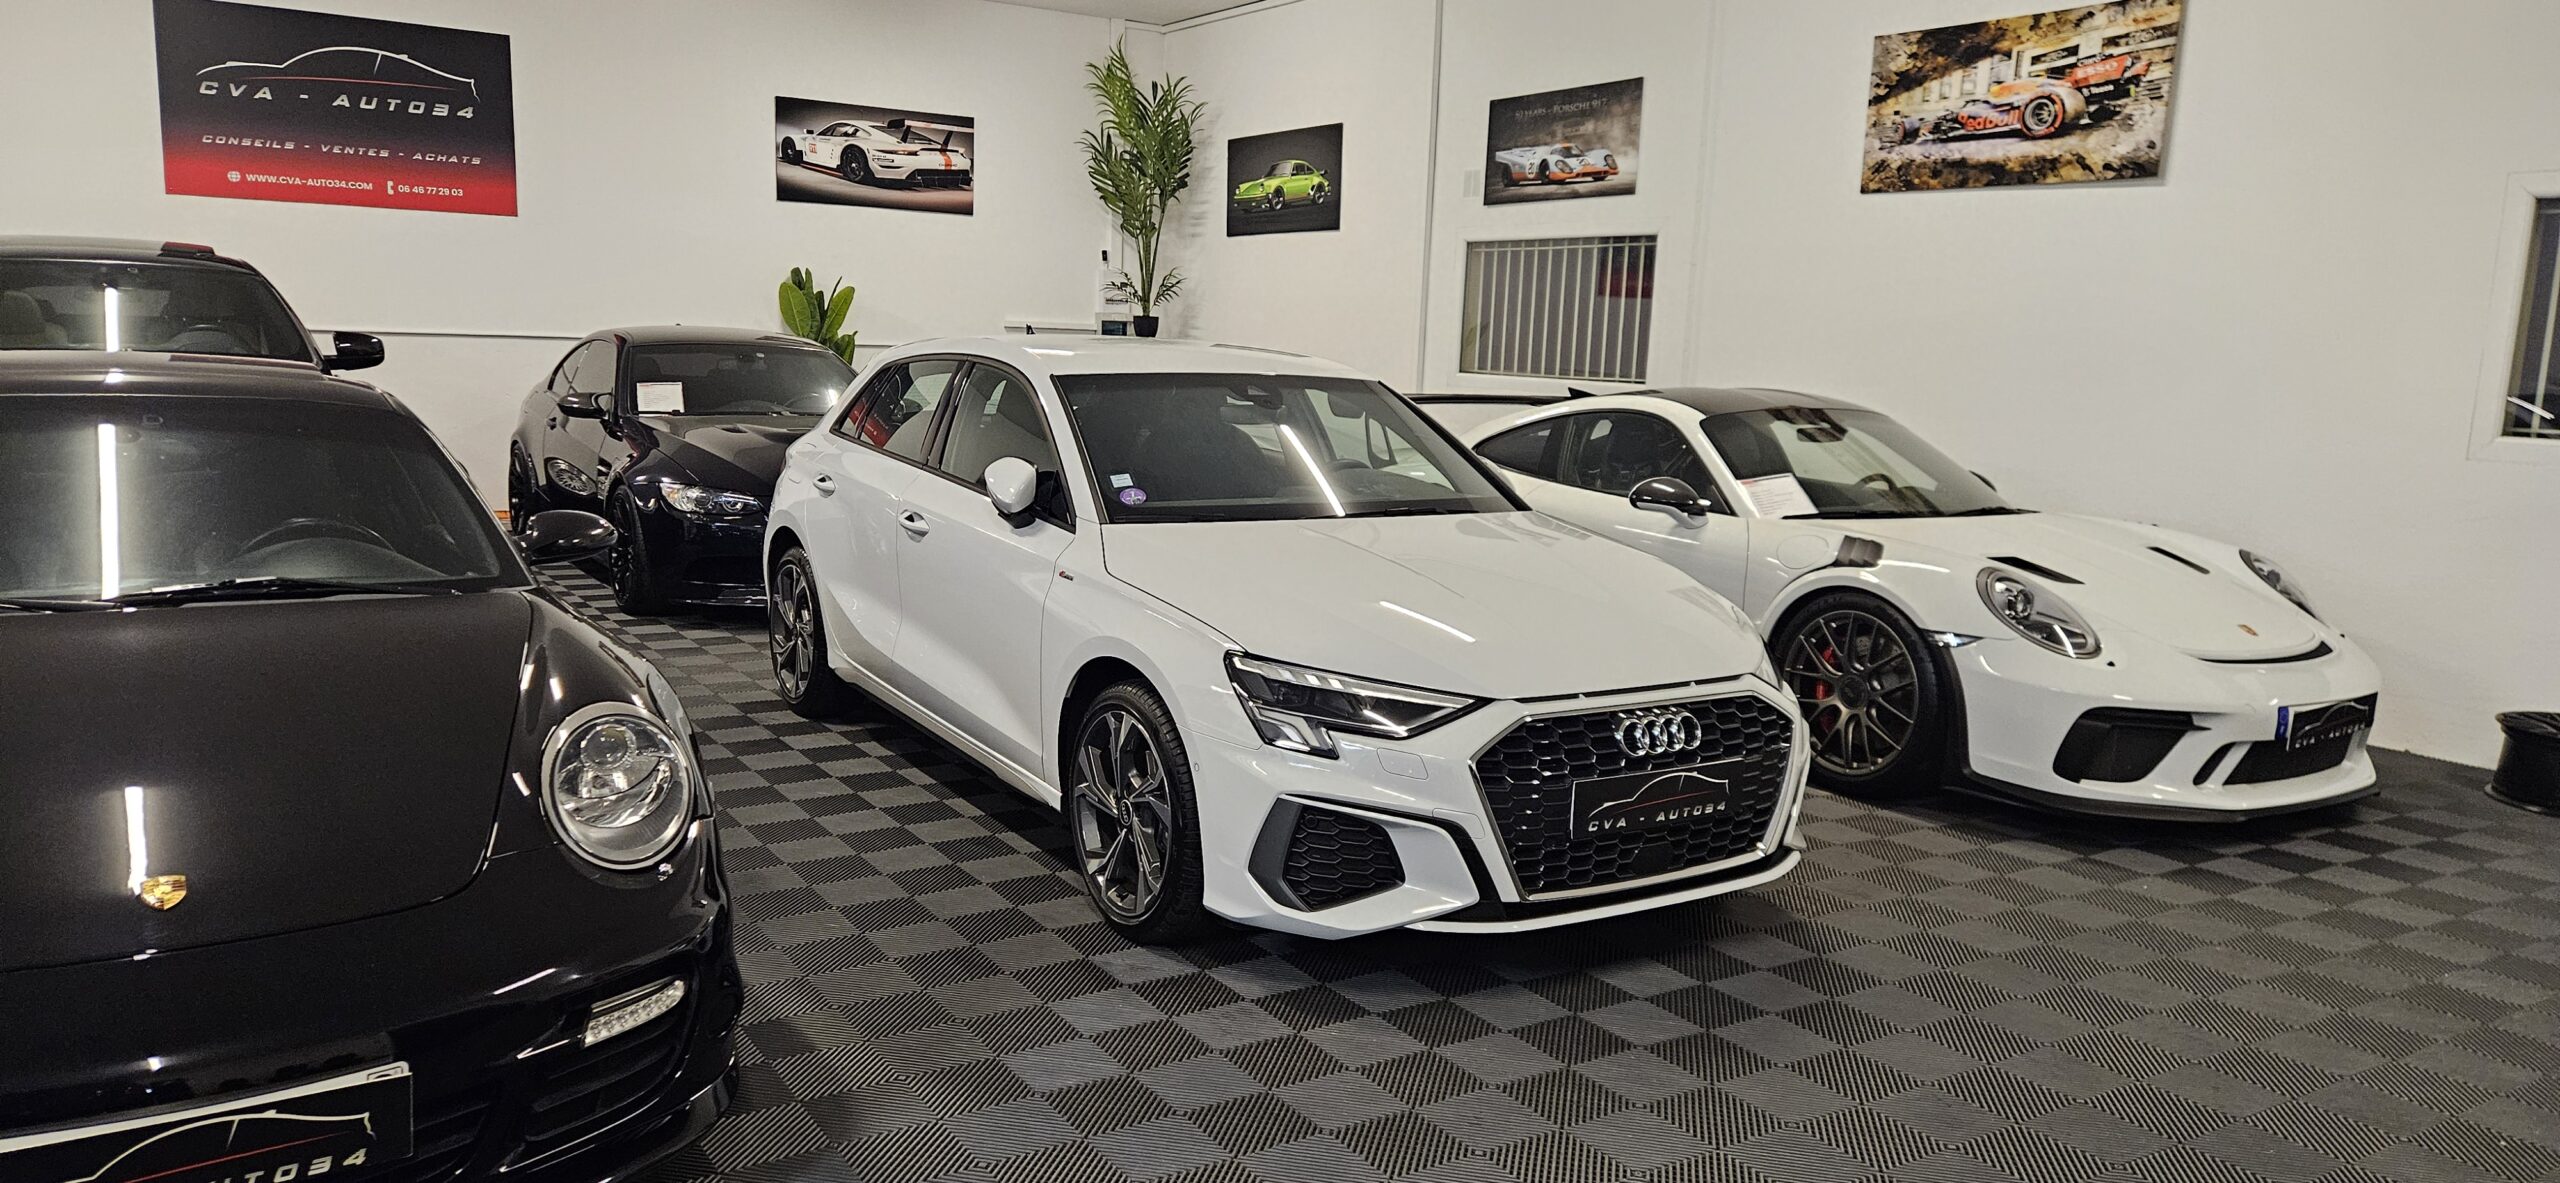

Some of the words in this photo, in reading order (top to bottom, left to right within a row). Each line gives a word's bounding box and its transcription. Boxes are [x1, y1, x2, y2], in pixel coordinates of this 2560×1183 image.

[199, 81, 272, 100] CVA
[331, 94, 474, 119] AUTO34
[201, 134, 295, 150] CONSEILS
[320, 144, 390, 157] VENTES
[412, 152, 481, 165] ACHATS
[245, 173, 373, 191] WWW.CVA-AUTO34.COM
[397, 184, 410, 194] 06
[411, 185, 425, 194] 46
[425, 186, 437, 195] 77
[438, 187, 450, 196] 29
[451, 188, 463, 197] 03
[1588, 817, 1627, 832] CVA
[1656, 801, 1726, 822] AUTO34
